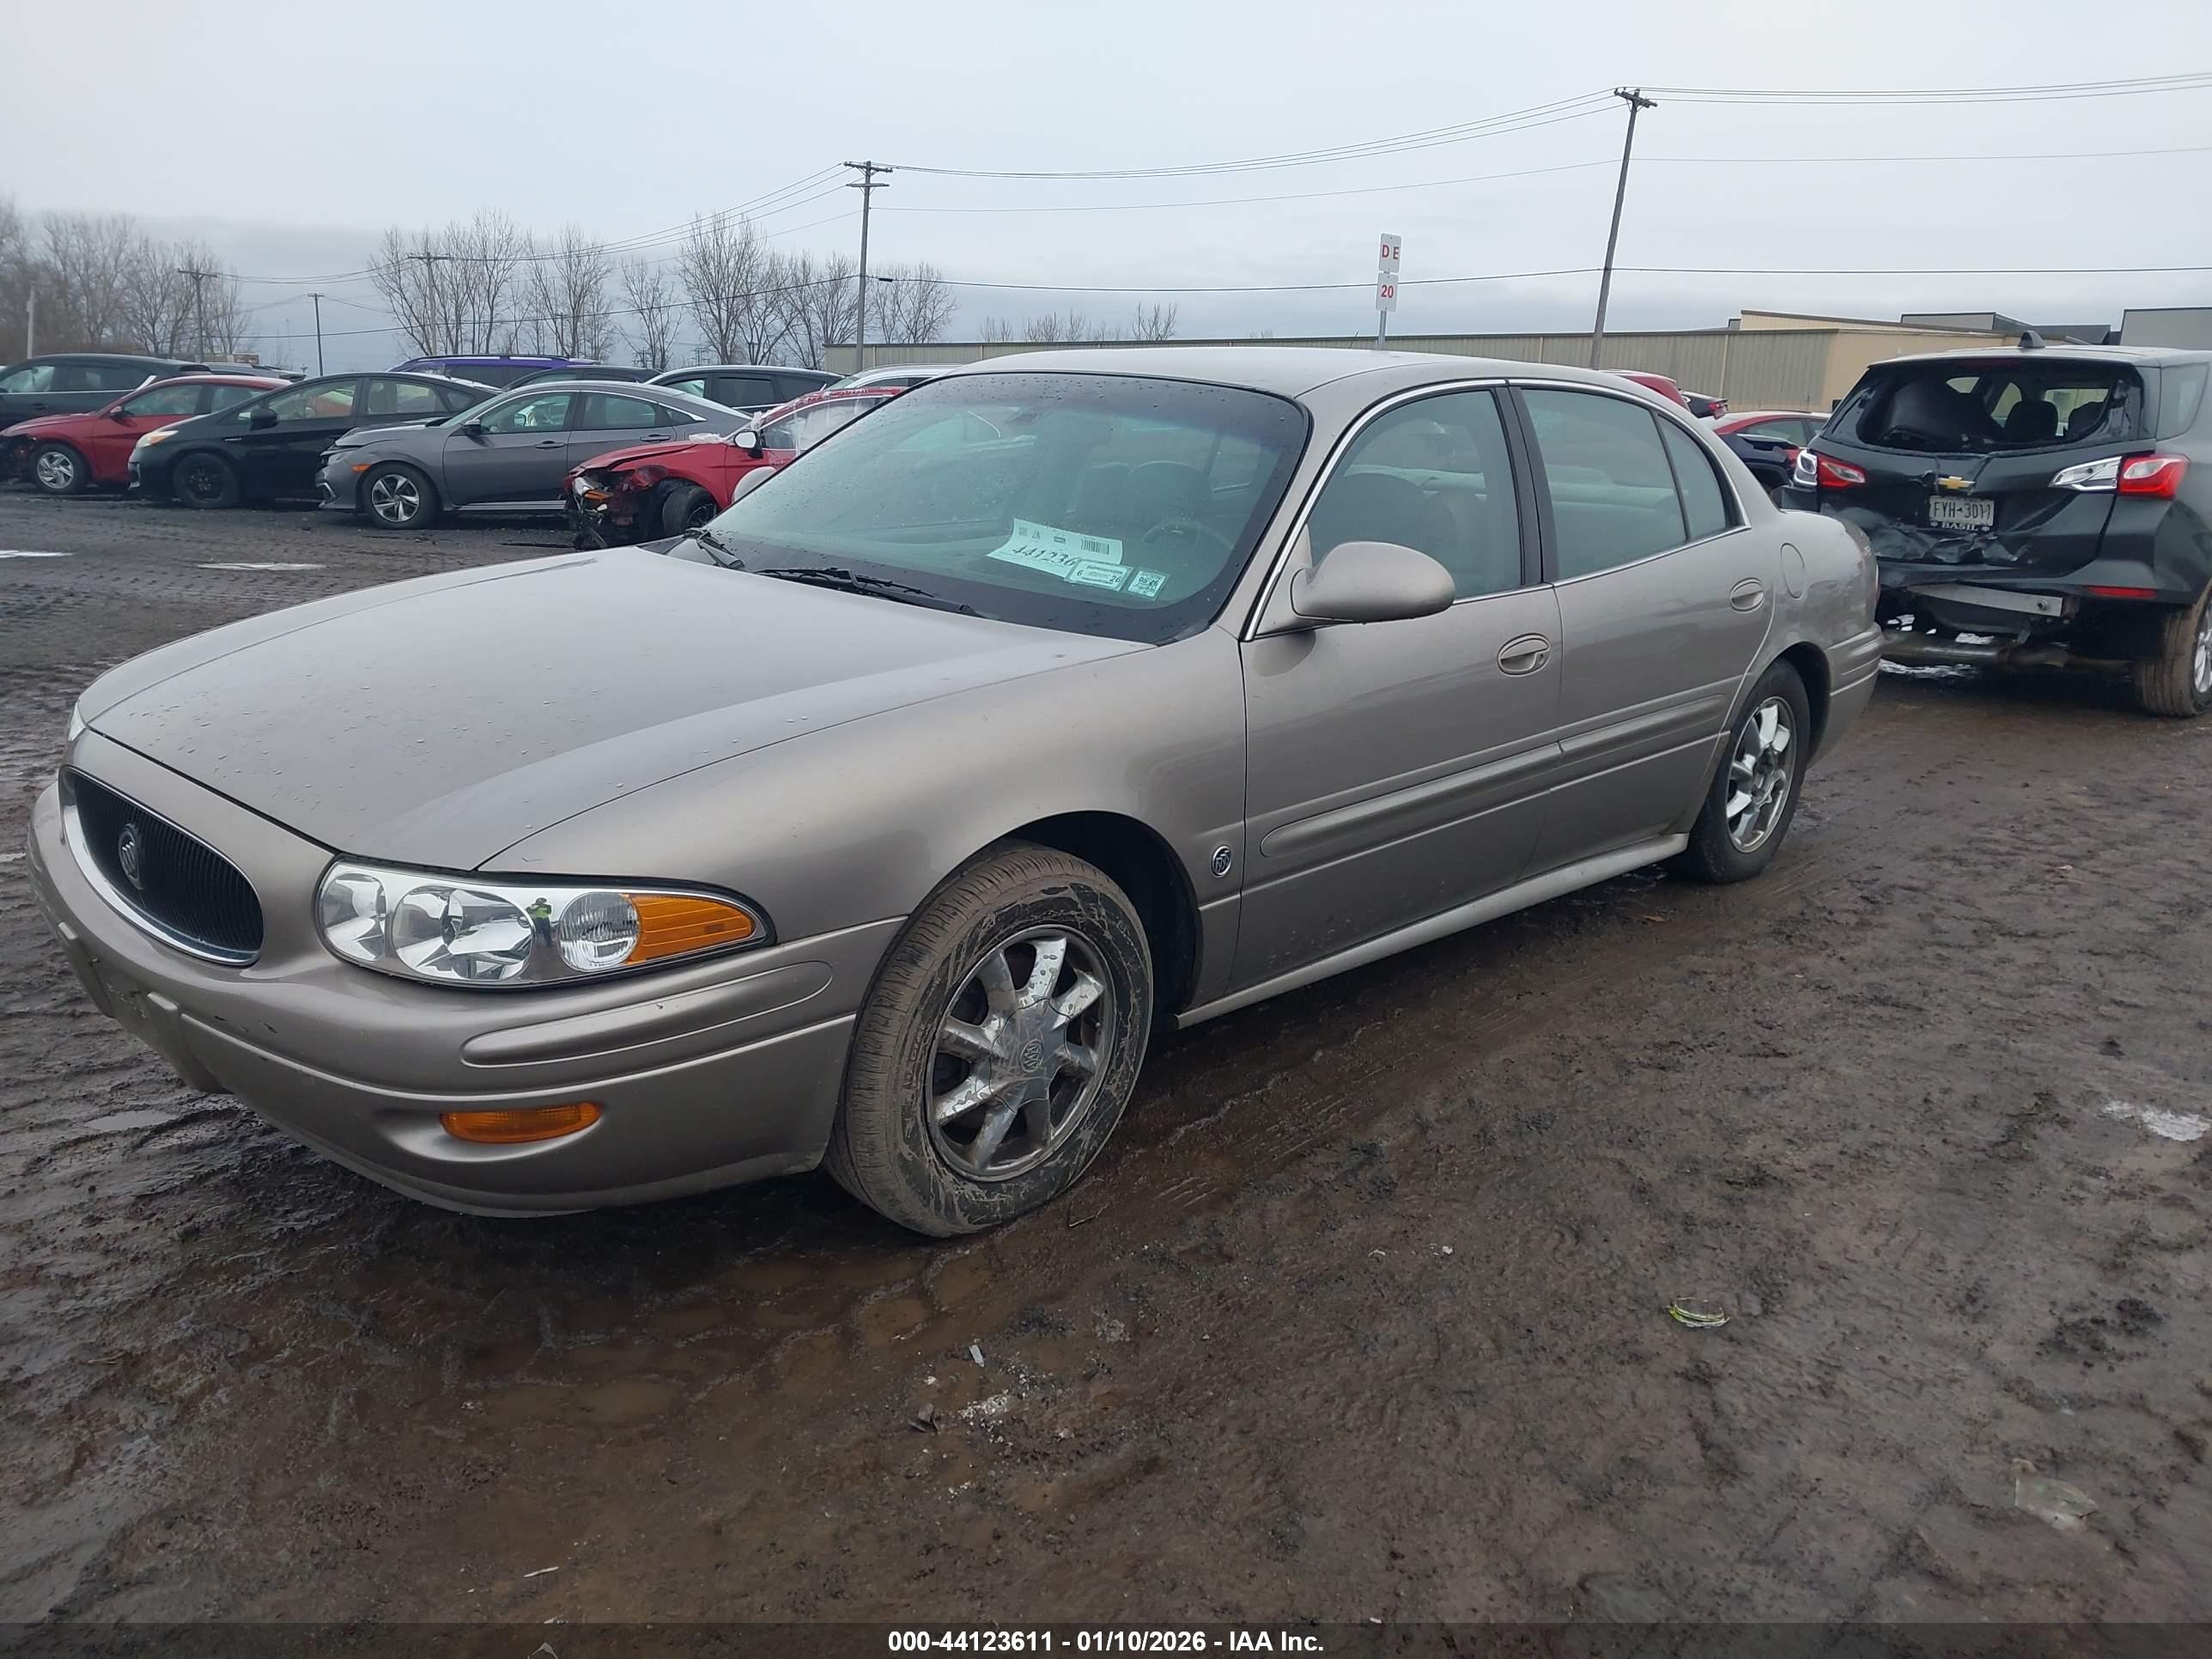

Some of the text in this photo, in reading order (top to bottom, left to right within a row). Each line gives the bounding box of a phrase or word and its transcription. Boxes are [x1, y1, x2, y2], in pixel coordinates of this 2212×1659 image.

[1382, 245, 1400, 259] D E
[1381, 285, 1394, 298] 20
[1942, 521, 1978, 532] BASIL
